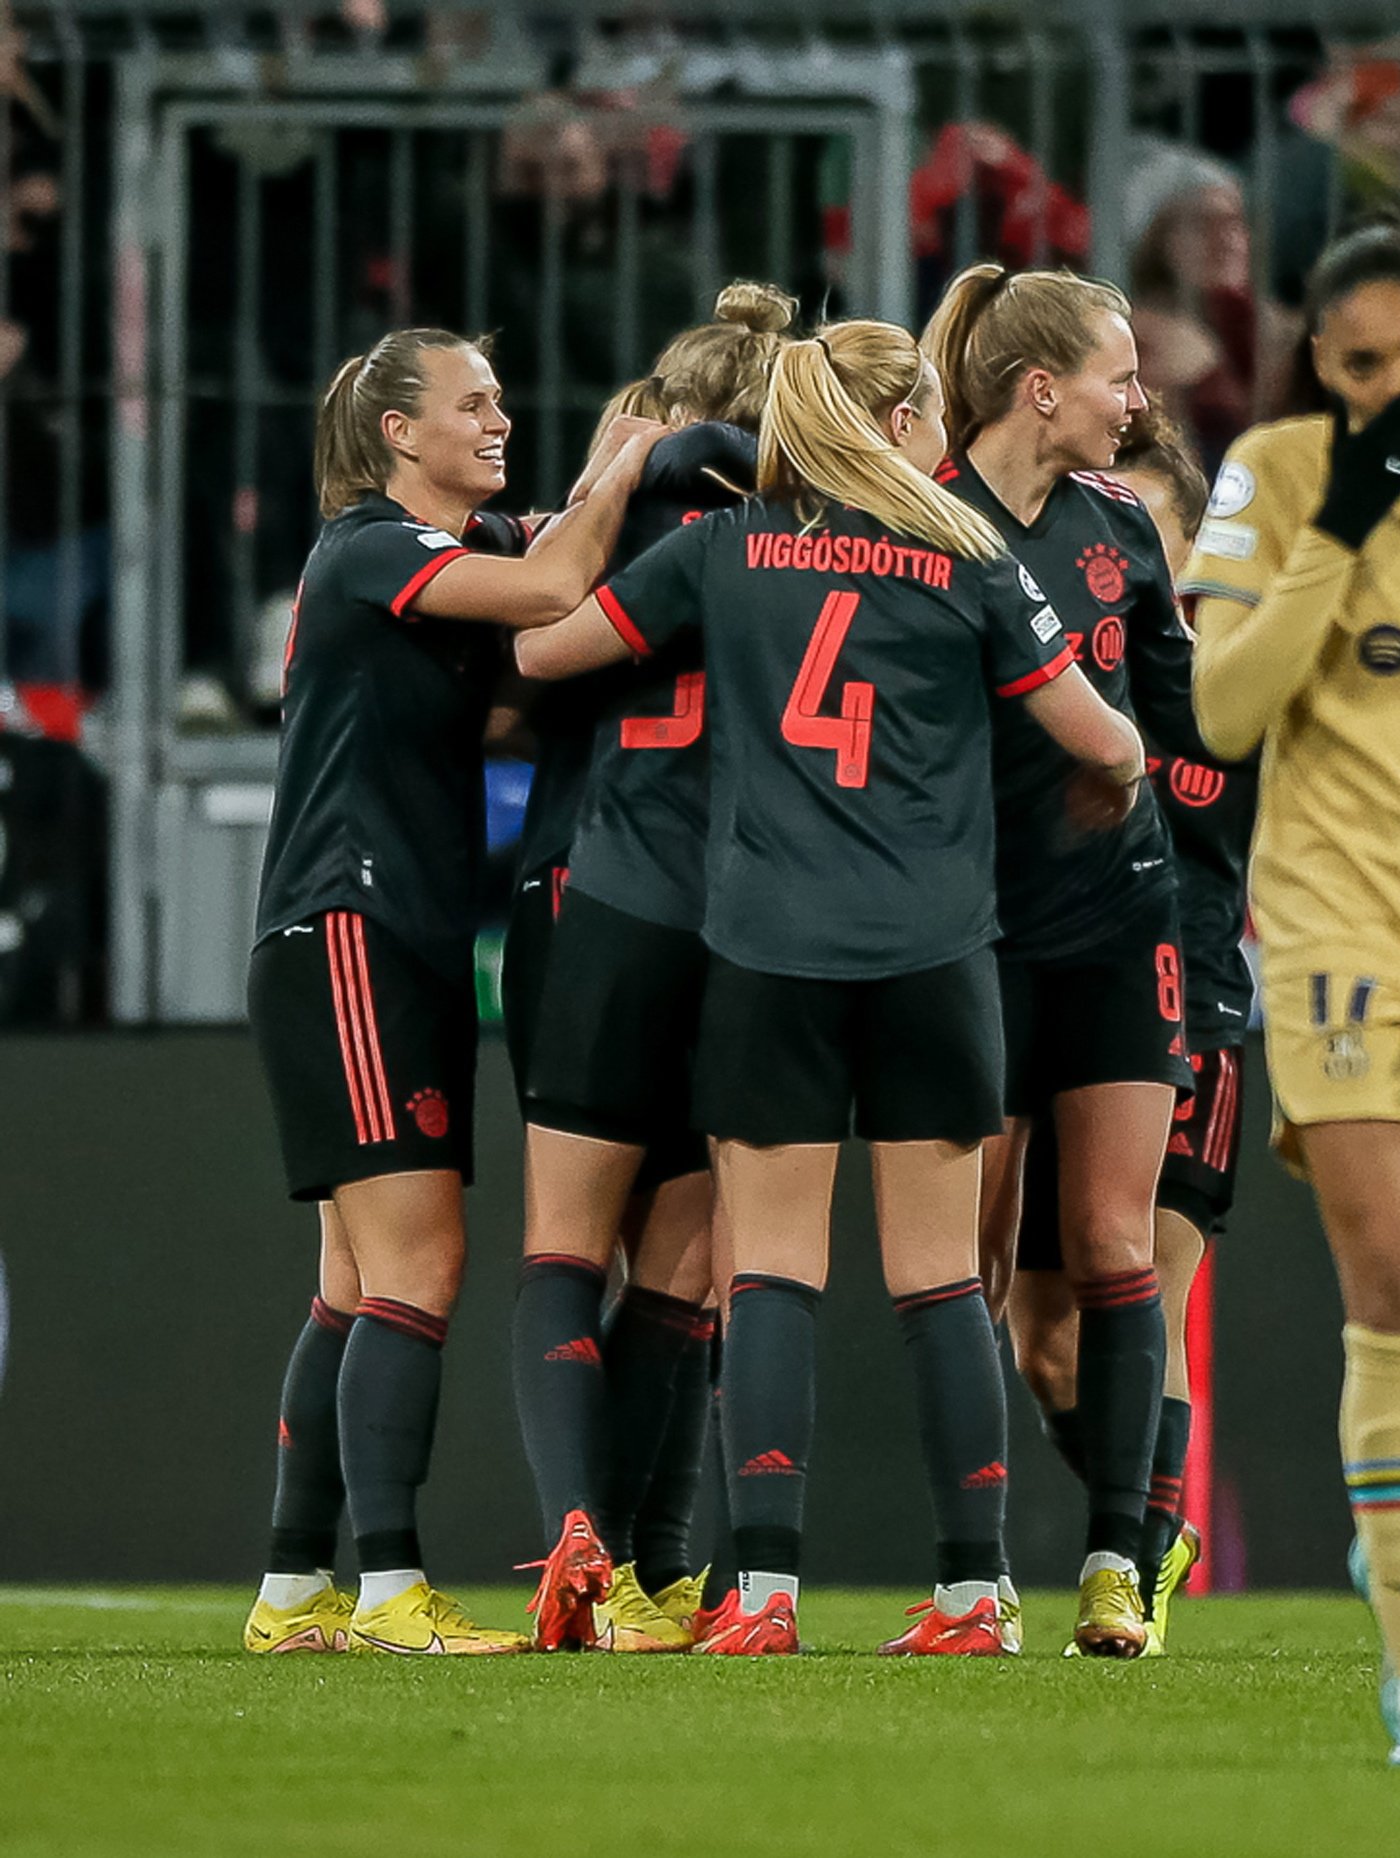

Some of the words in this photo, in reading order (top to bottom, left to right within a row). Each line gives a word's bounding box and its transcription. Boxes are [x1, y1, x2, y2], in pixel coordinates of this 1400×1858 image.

[781, 590, 874, 788] 4
[1155, 943, 1181, 1022] 8
[1309, 970, 1376, 1028] 11
